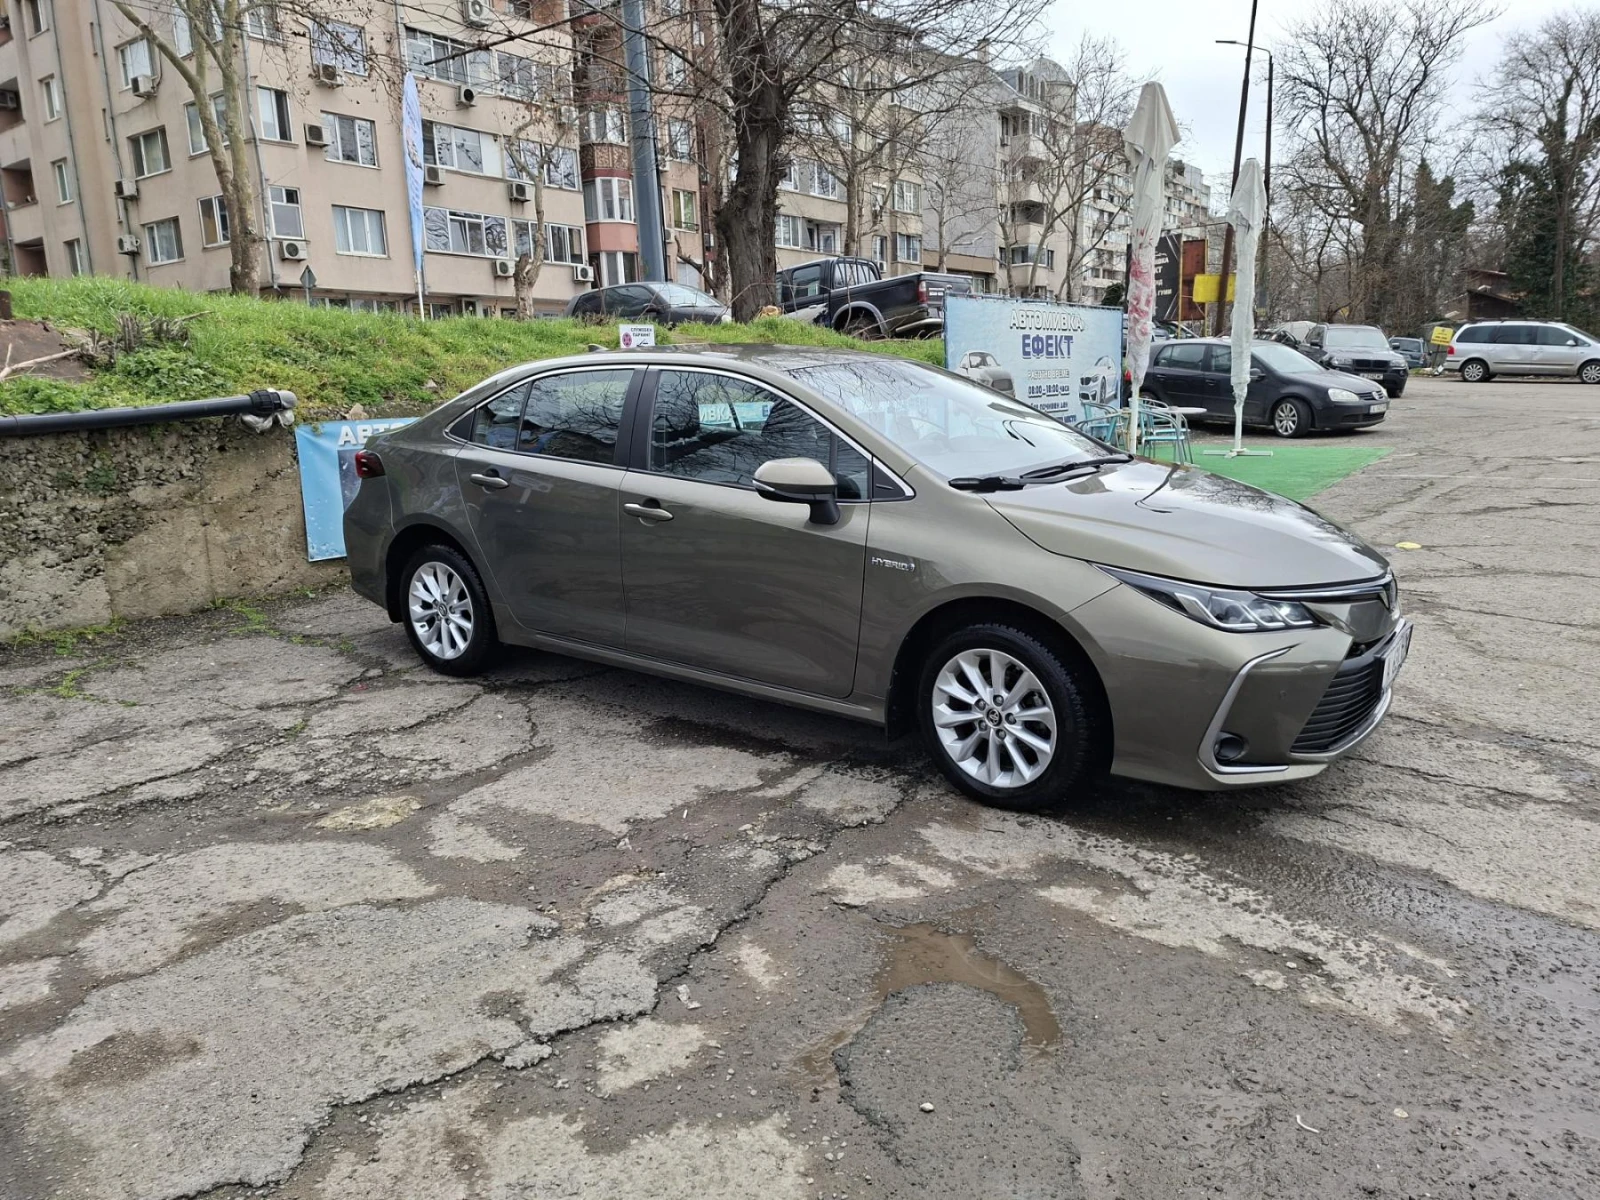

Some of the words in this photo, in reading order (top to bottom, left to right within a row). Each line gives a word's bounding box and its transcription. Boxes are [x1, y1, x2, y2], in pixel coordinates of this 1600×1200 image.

[1010, 309, 1084, 331] АВТОМИВКА
[1022, 334, 1074, 359] ЕФЕКТ
[871, 556, 908, 571] HYBRID
